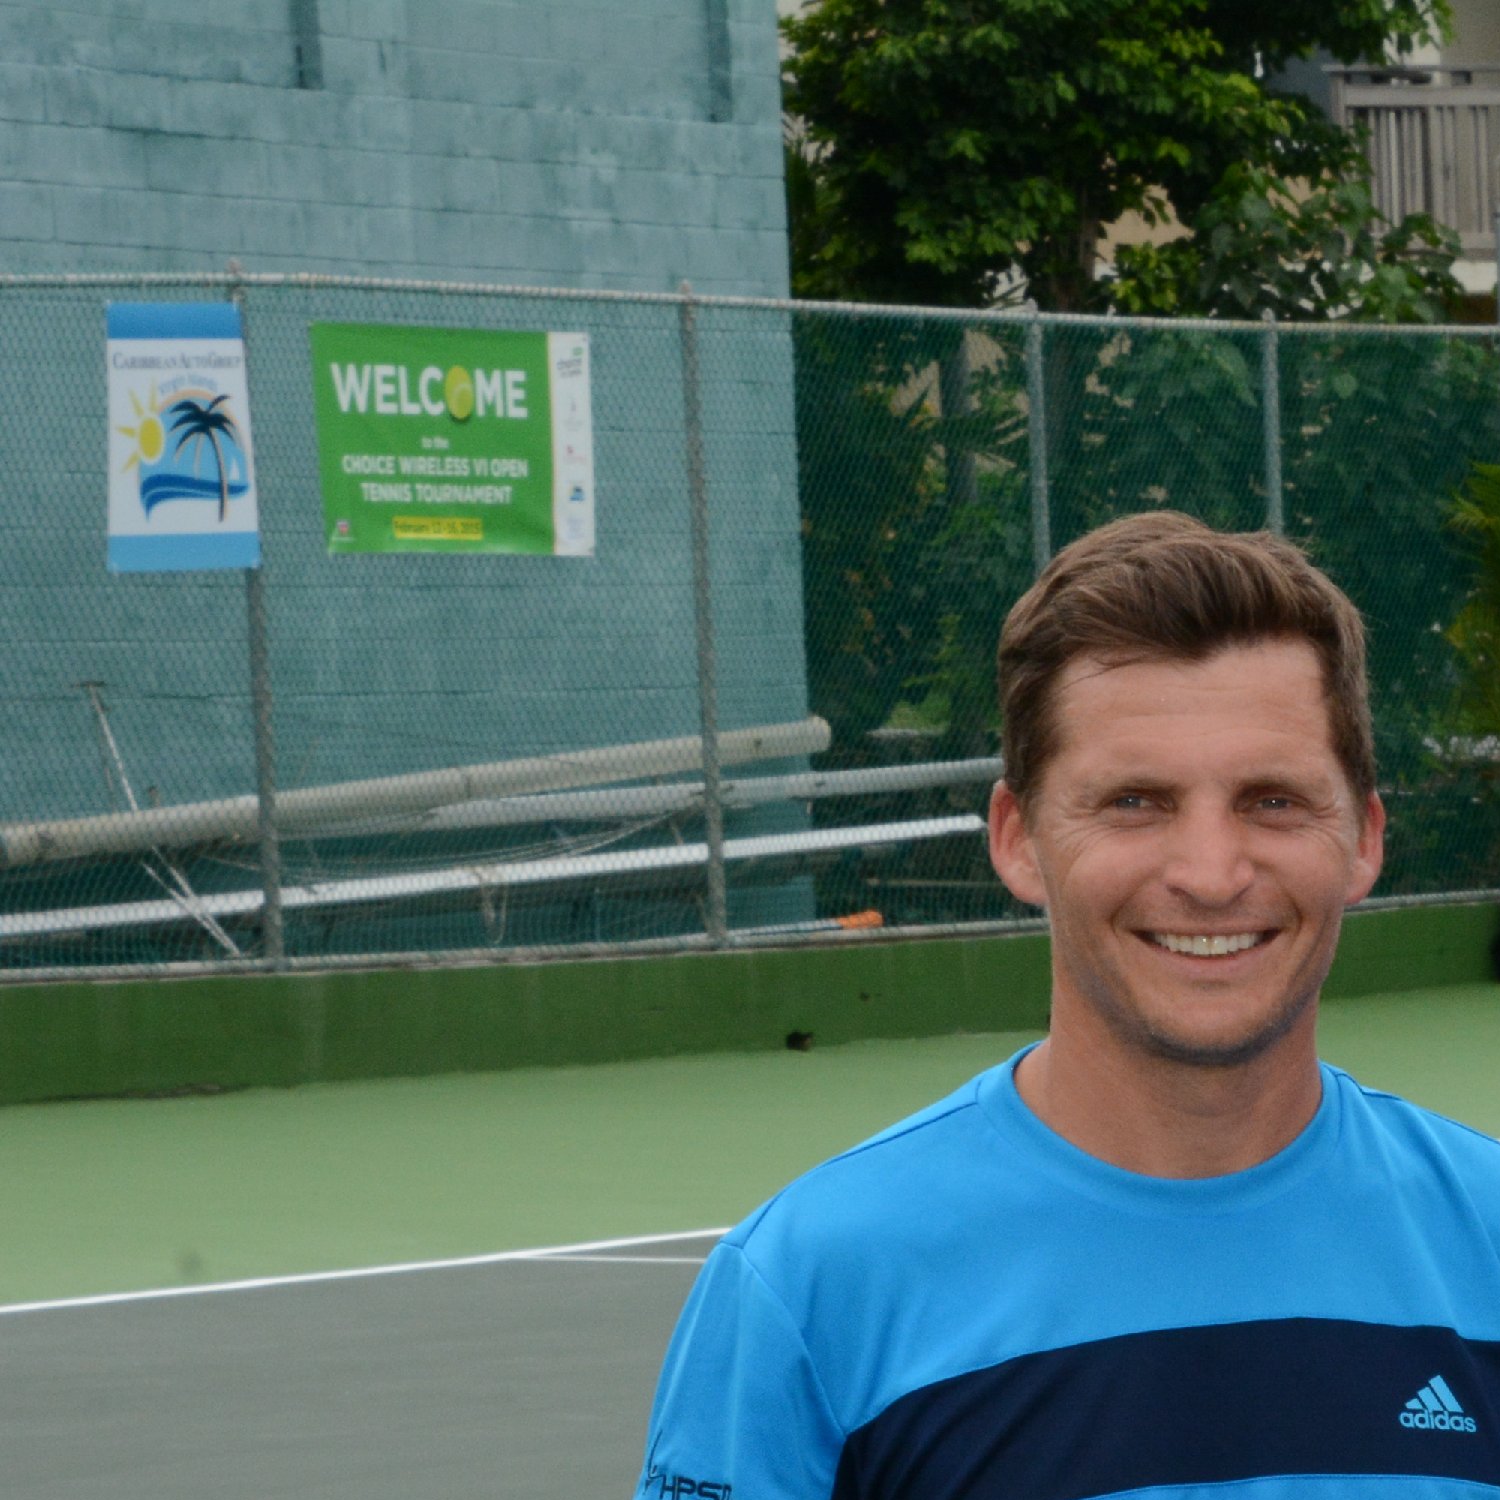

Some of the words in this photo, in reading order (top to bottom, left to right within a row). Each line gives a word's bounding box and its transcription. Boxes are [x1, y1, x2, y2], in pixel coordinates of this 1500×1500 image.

[330, 362, 528, 420] WELCOME
[342, 454, 396, 475] CHOICE
[399, 455, 470, 476] WIRELESS
[472, 457, 489, 477] VI
[490, 458, 529, 478] OPEN
[361, 481, 412, 502] TENNIS
[415, 483, 513, 504] TOURNAMENT
[1399, 1409, 1477, 1433] adidas
